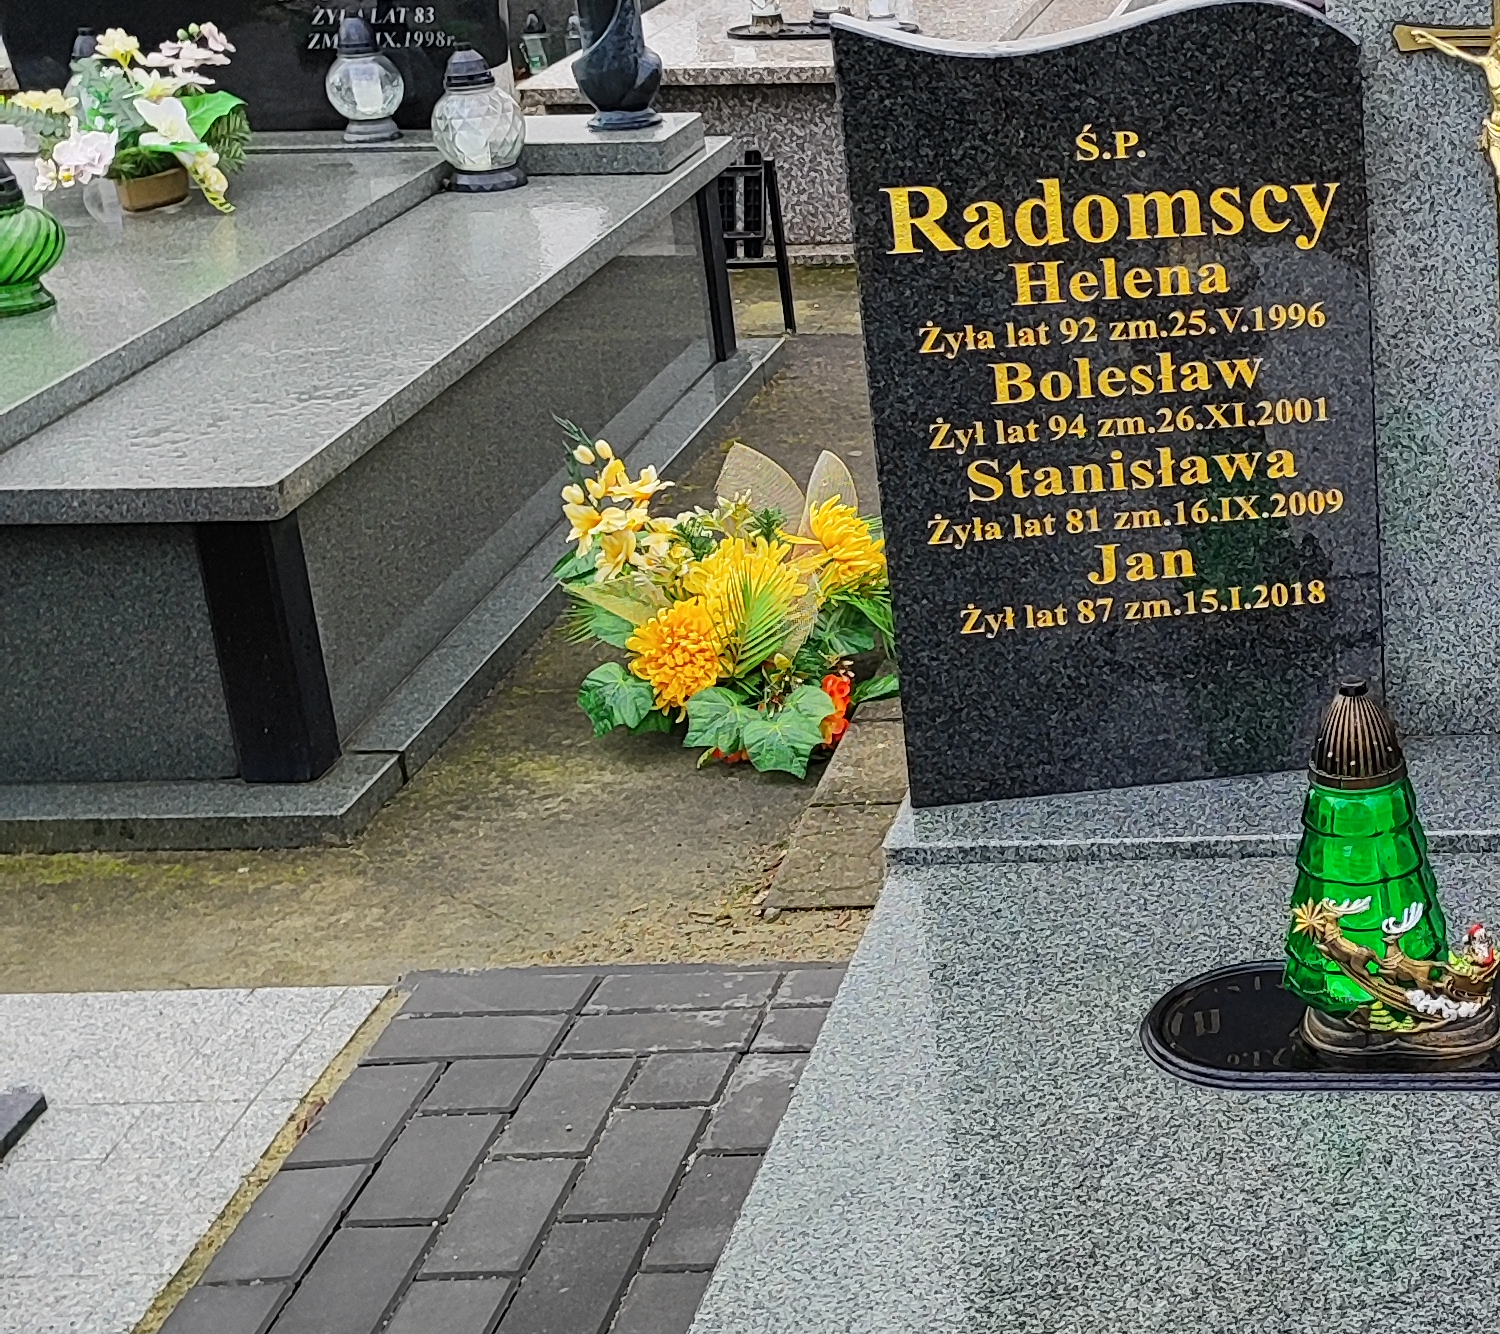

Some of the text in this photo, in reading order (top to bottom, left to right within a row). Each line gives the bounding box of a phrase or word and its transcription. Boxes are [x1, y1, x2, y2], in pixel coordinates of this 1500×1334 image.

[370, 6, 409, 25] LAT
[414, 6, 436, 25] 83
[879, 177, 1341, 255] Radomscy
[1009, 258, 1230, 306] Helena
[918, 301, 1327, 358] Żyła lat 92 zm.25.V.1996
[988, 352, 1264, 405] Bolesław
[928, 396, 1330, 454] Żył lat 94 zm.26.XI.2001
[966, 446, 1299, 503] Stanisława
[927, 488, 1345, 549] Żyła lat 81 zm.16.IX.2009
[1086, 543, 1197, 586] Jan
[960, 579, 1327, 639] Żył lat 87 zm.15.I.2018
